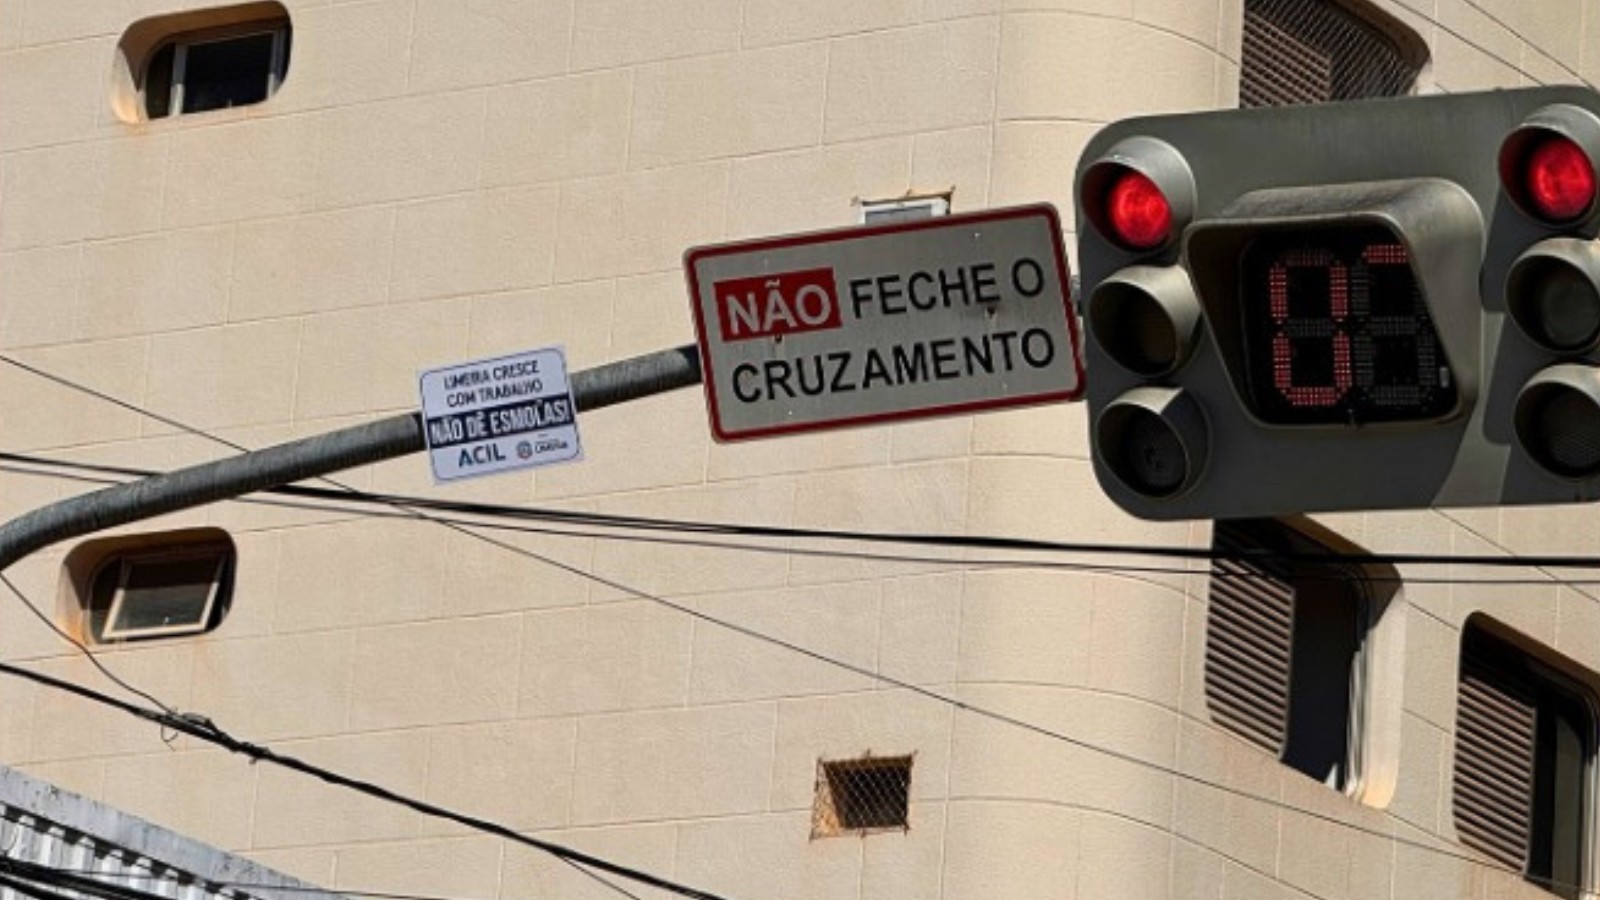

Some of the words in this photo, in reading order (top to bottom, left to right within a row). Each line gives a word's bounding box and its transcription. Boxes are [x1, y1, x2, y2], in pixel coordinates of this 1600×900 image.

[725, 278, 832, 335] NÃO
[849, 262, 1001, 319] FECHE
[1010, 257, 1046, 298] O
[444, 370, 490, 390] LIMEIRA
[493, 360, 540, 380] CRESCE
[732, 327, 1056, 404] CRUZAMENTO
[446, 390, 476, 408] COM
[478, 378, 543, 402] TRABALHO
[430, 416, 465, 445] NÃO
[466, 411, 488, 438] DÊ
[490, 399, 571, 435] ESMOLAS!
[458, 443, 506, 468] ACIL
